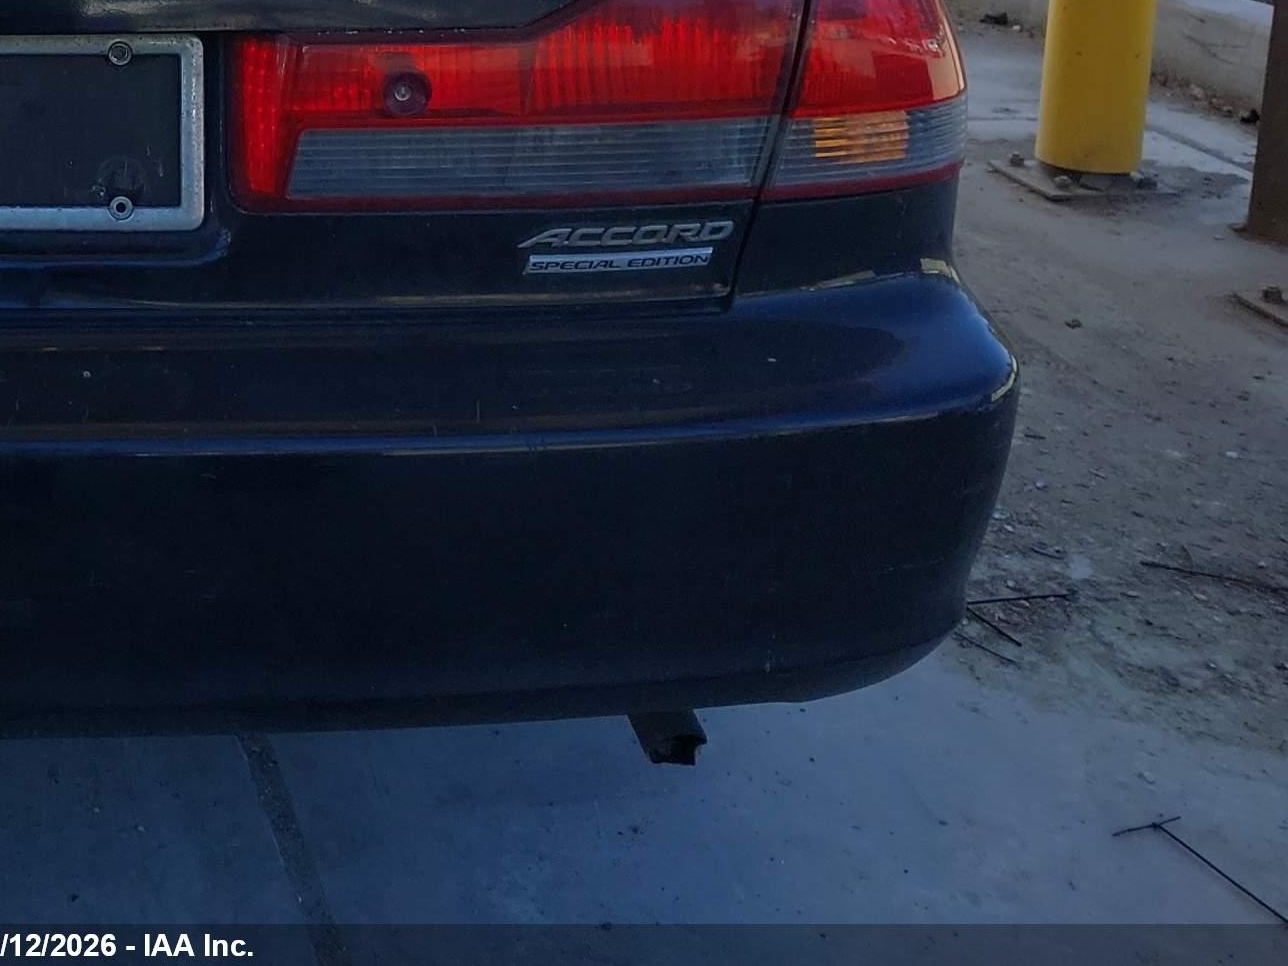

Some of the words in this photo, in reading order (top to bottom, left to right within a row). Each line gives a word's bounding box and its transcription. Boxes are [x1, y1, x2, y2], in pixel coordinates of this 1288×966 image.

[517, 220, 734, 249] ACCORD
[530, 259, 621, 272] SPECIAL
[627, 254, 710, 269] EDITION
